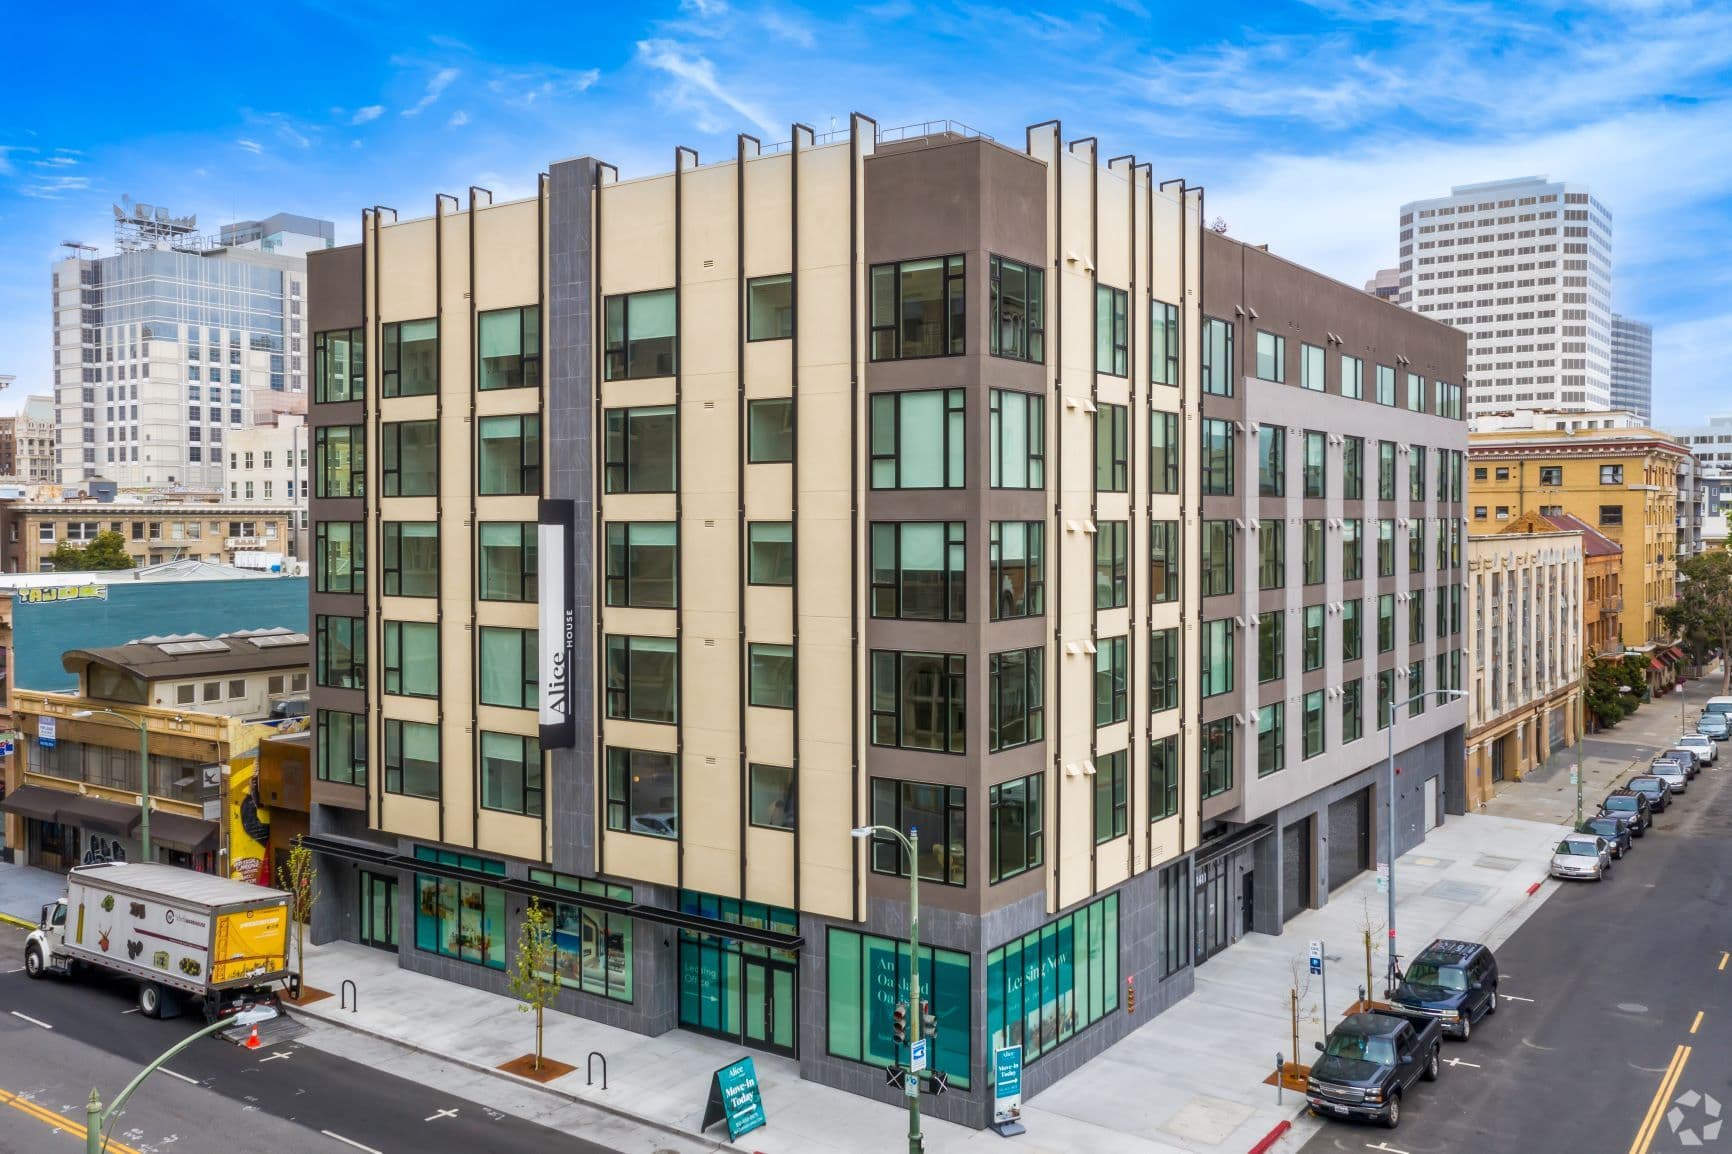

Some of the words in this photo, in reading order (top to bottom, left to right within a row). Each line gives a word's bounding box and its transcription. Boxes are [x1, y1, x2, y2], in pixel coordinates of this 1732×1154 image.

[548, 652, 566, 715] Alice
[878, 957, 895, 971] An
[685, 975, 709, 986] Offce
[878, 974, 929, 996] Oalad
[729, 1066, 743, 1076] Alice
[725, 1078, 755, 1098] Move-In
[730, 1091, 754, 1108] Today
